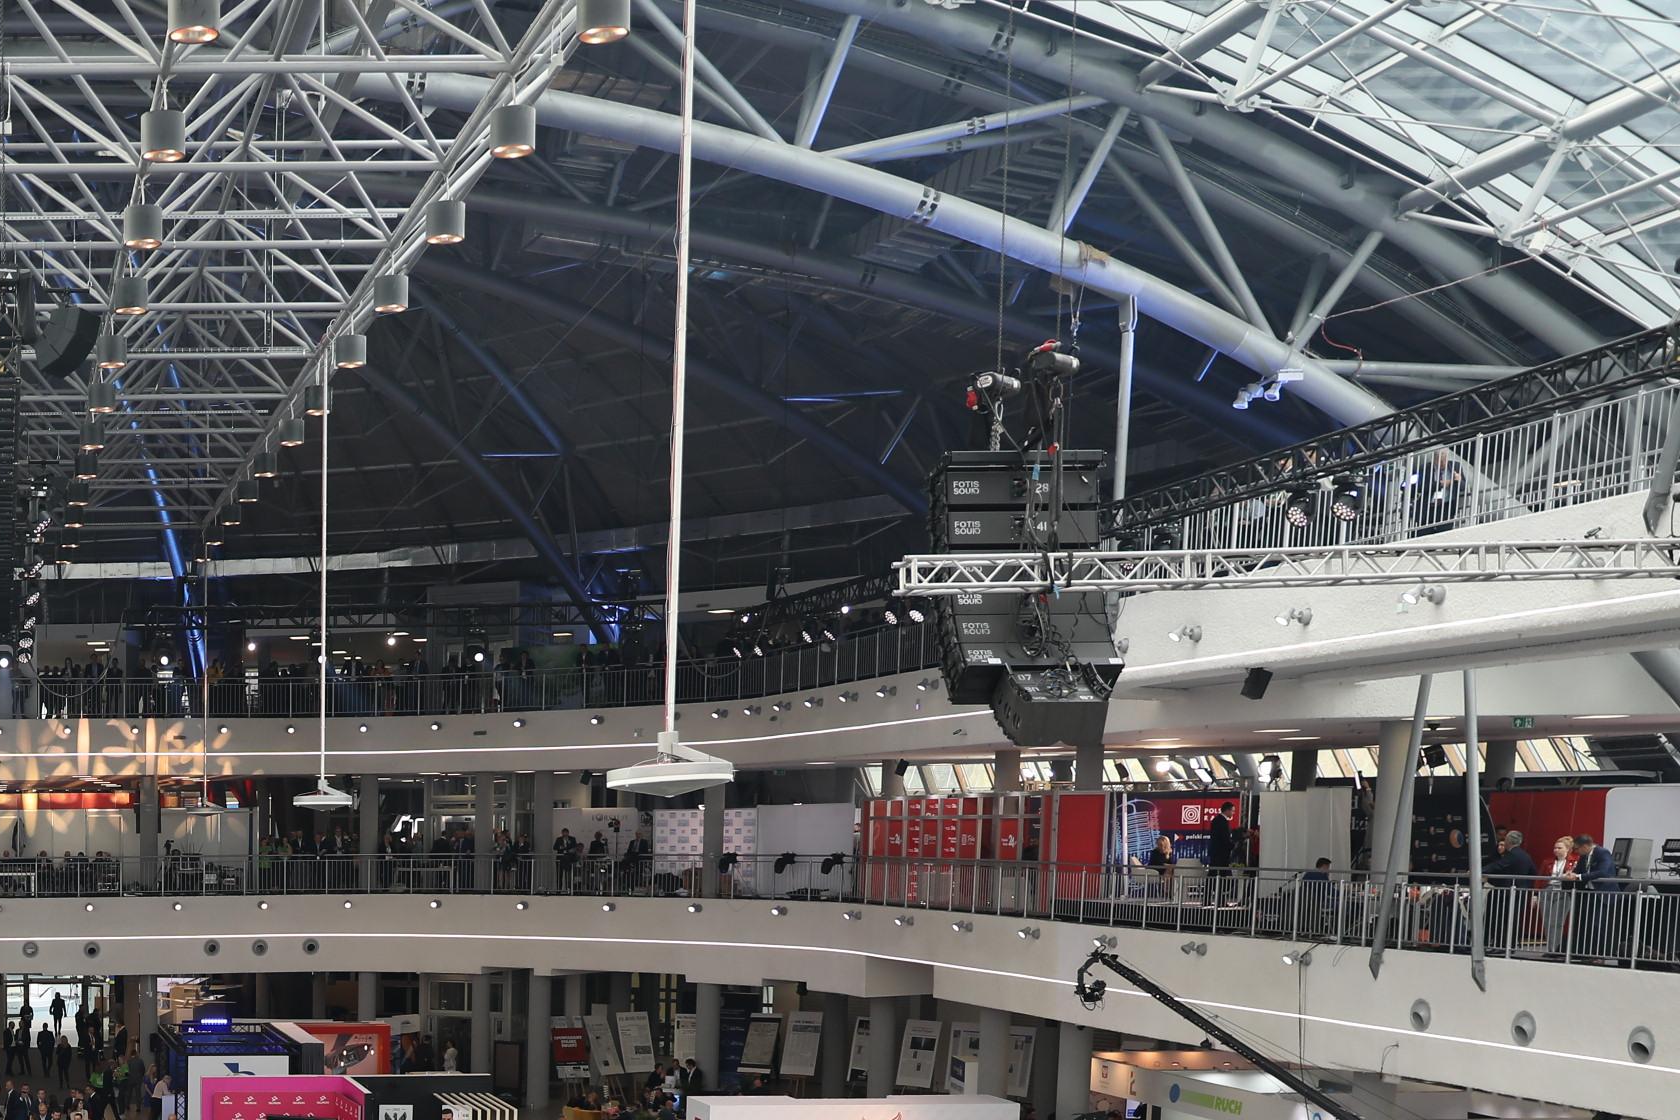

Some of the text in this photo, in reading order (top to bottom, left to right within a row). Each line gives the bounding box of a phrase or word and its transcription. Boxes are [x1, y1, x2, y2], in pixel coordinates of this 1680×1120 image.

[953, 480, 980, 488] FOTIS
[1035, 483, 1049, 493] 28
[954, 520, 981, 528] FOTIS
[1214, 1097, 1243, 1116] RUCH
